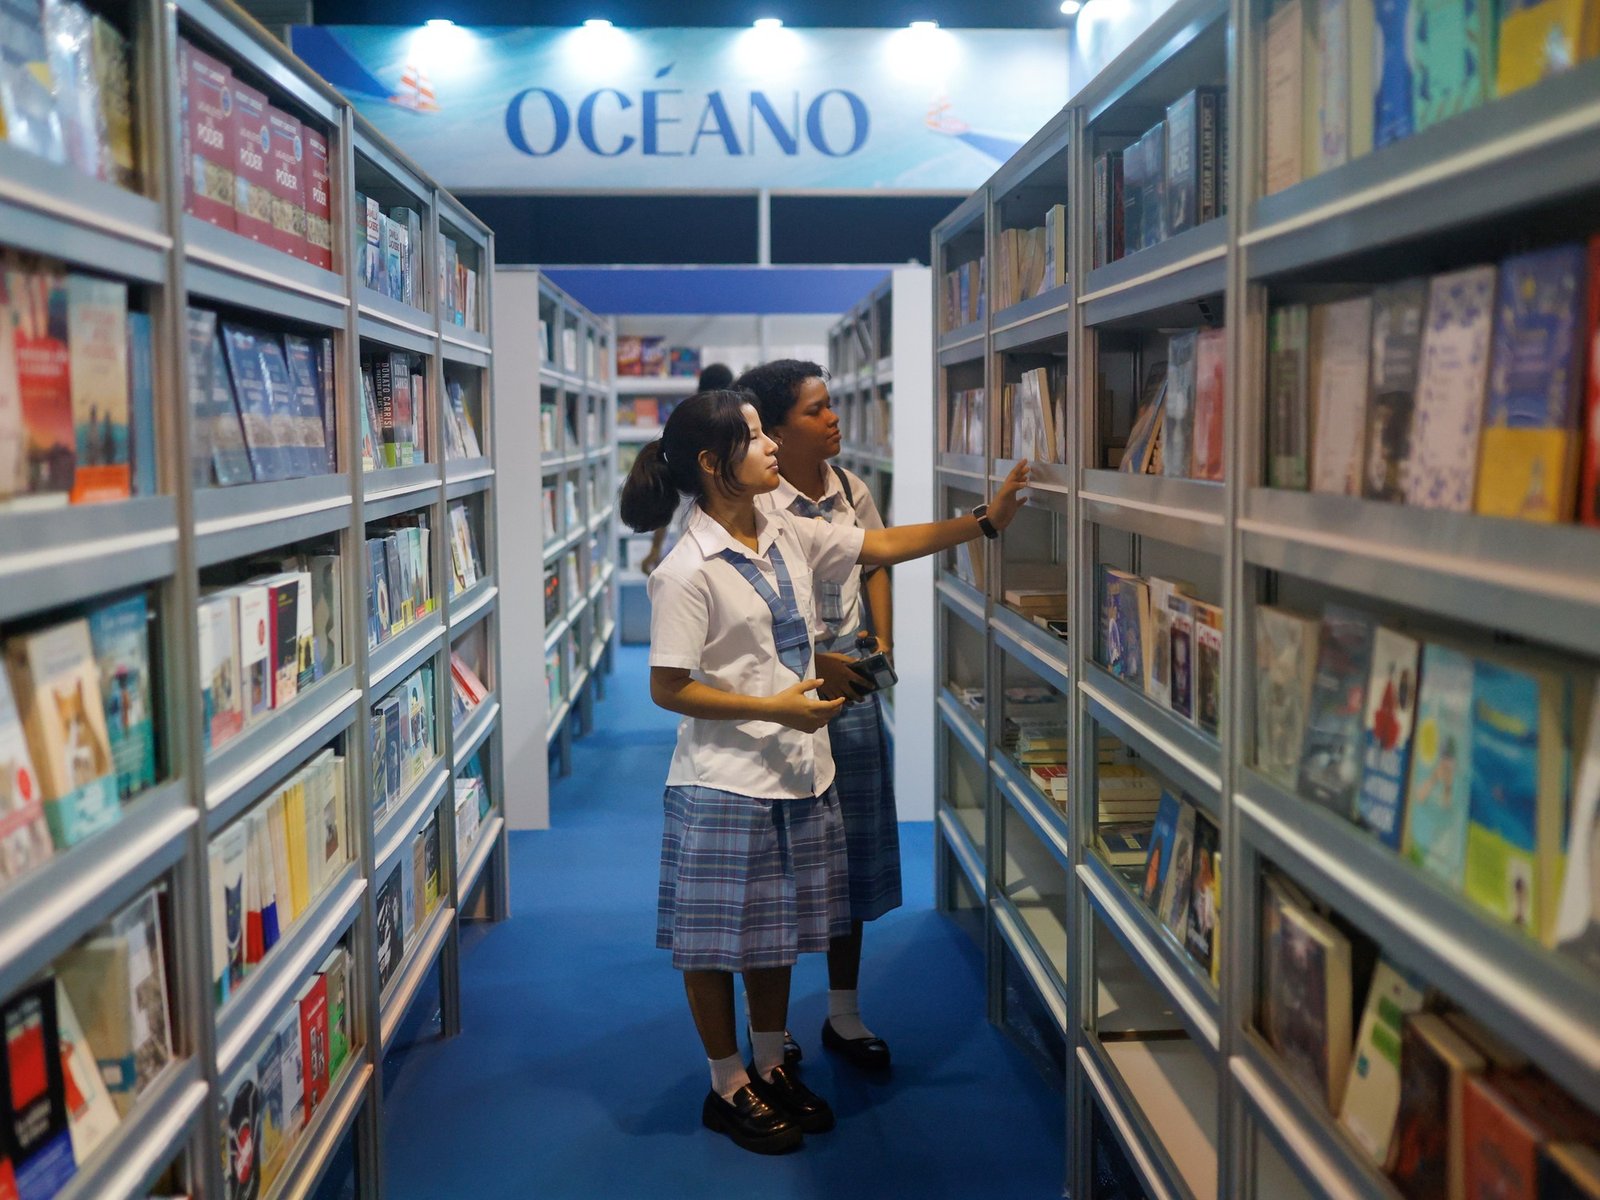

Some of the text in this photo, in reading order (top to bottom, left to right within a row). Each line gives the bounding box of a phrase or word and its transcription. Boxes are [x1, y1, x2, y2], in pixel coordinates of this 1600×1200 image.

[505, 61, 870, 157] OCÉANO
[382, 362, 392, 428] DONATO CARRISI
